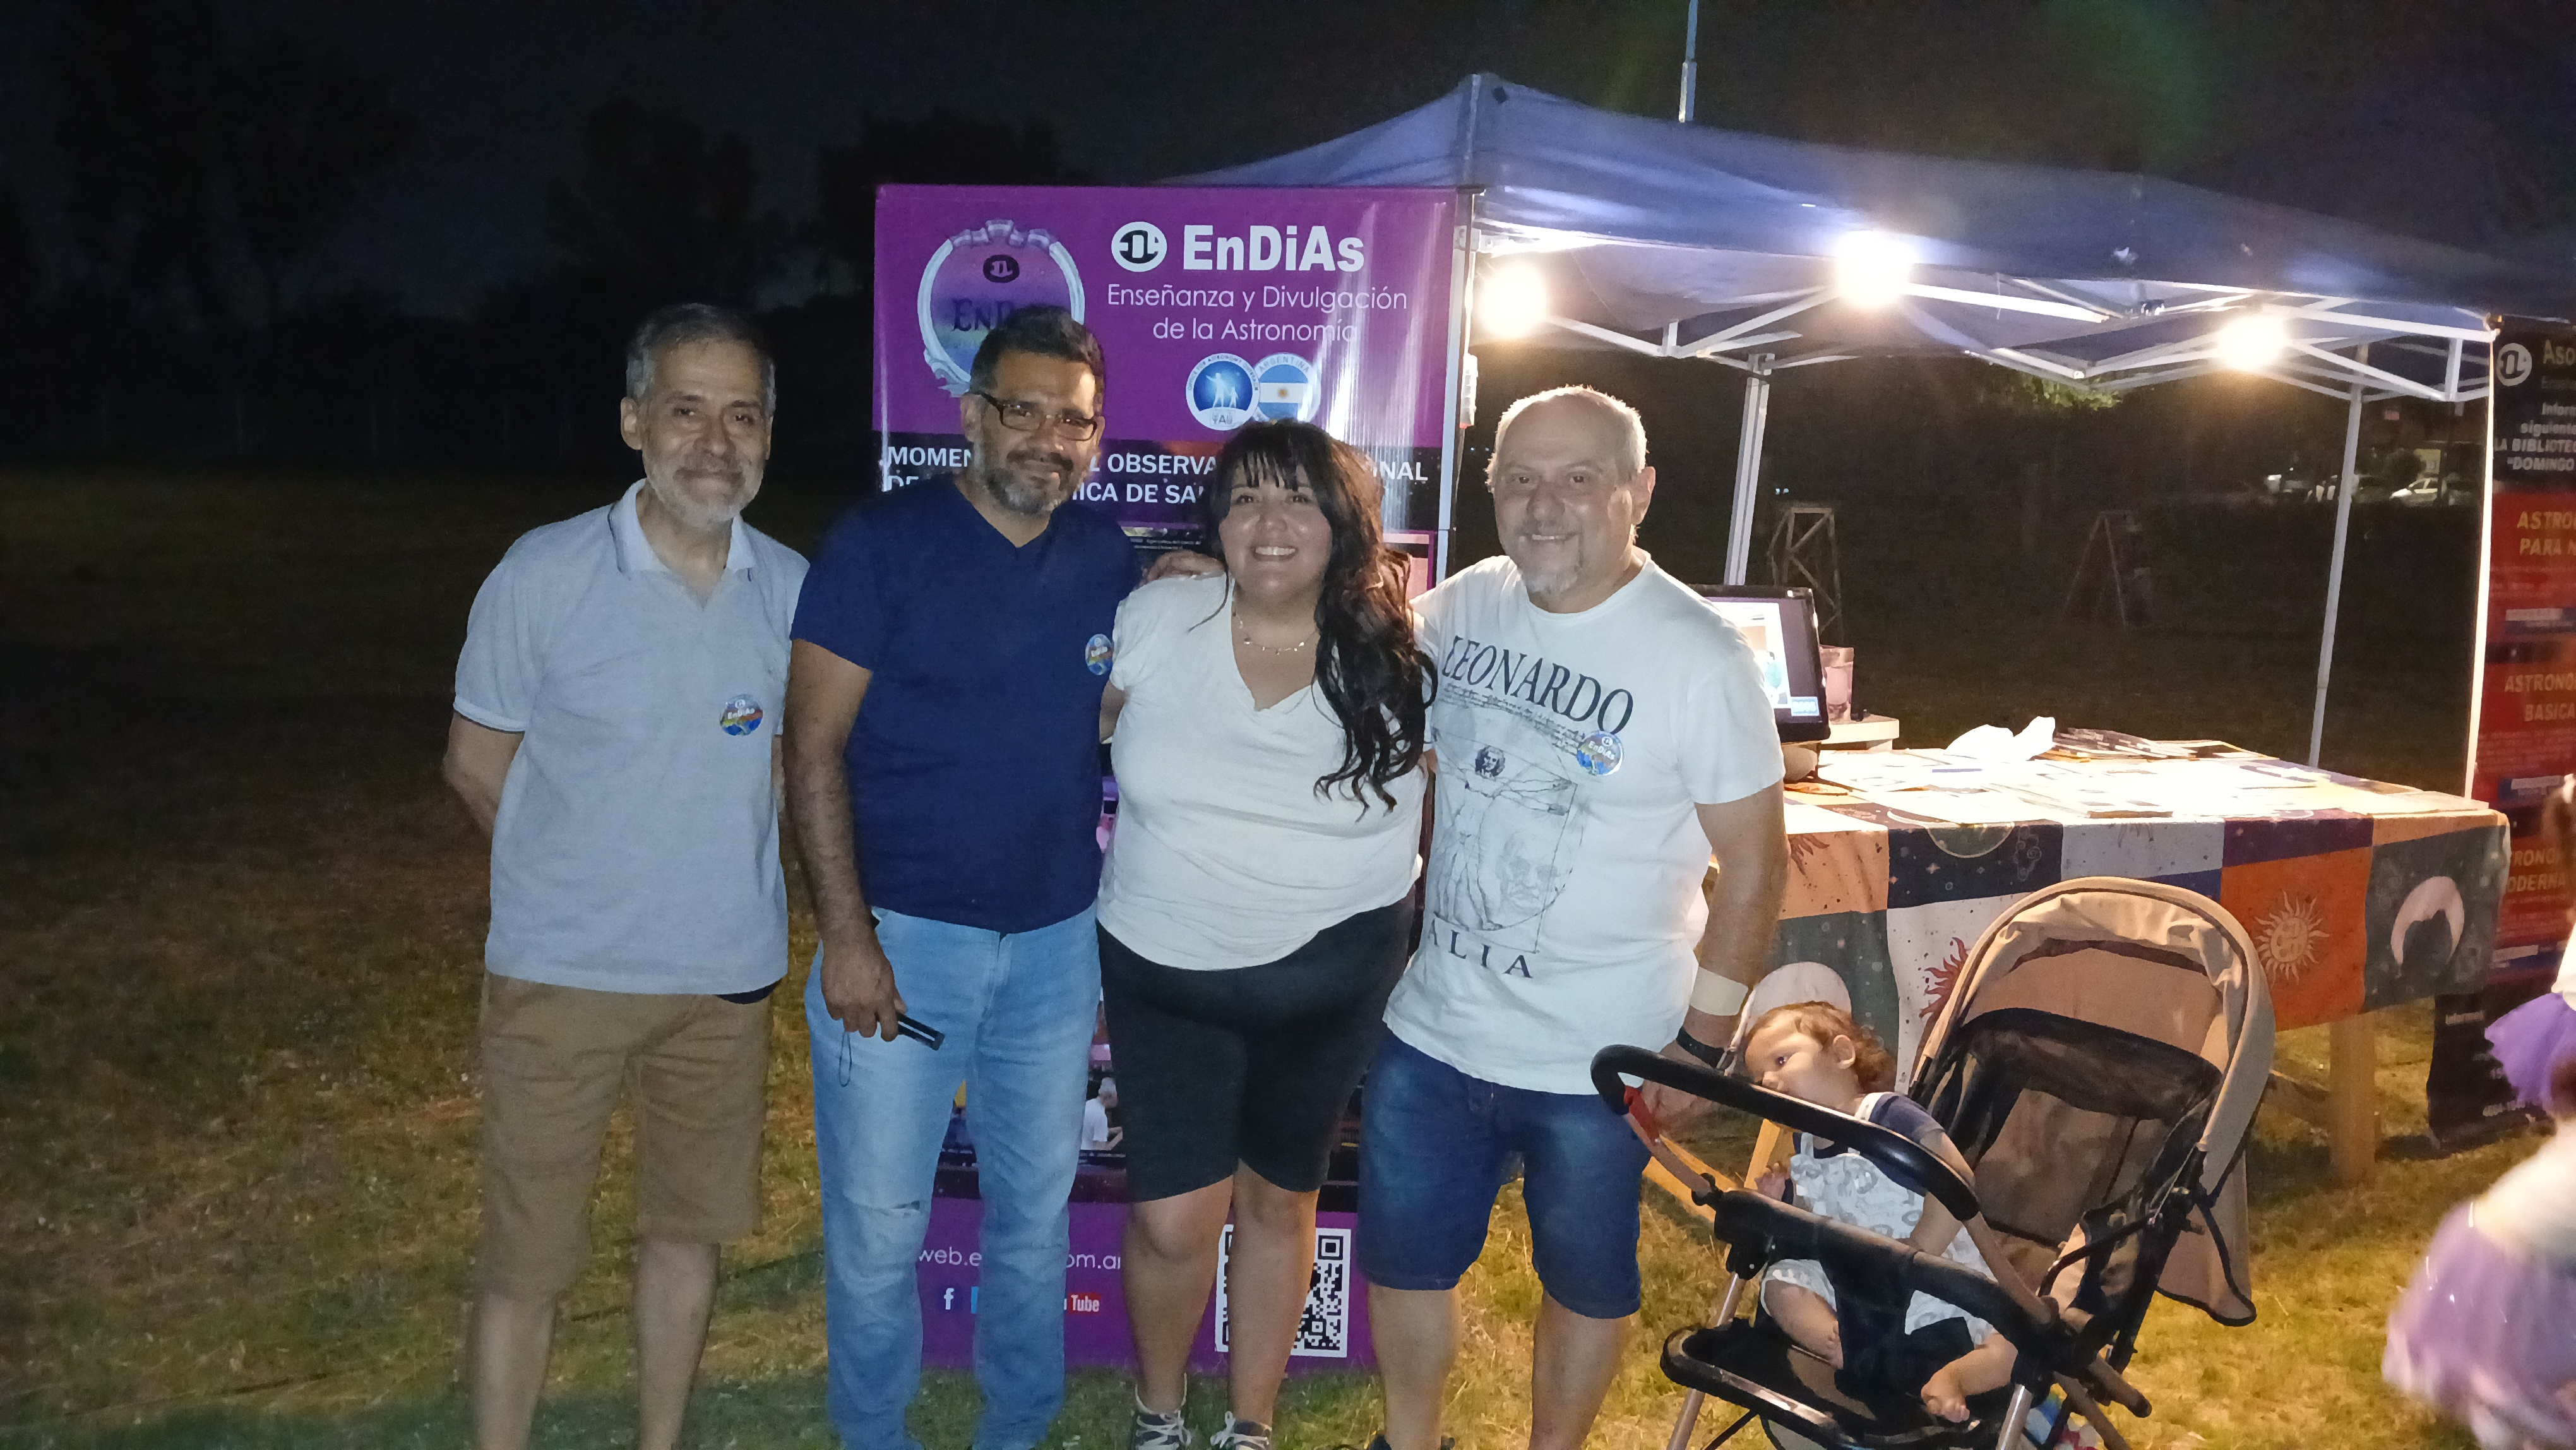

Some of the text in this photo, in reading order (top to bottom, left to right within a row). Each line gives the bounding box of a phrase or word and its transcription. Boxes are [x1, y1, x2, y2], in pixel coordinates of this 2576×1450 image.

[1183, 224, 1364, 272] EnDiAs
[1107, 284, 1407, 314] Enseñanza y Divulgación
[1153, 317, 1357, 342] de la Astronomía
[1258, 355, 1310, 374] ARGENTINA
[1107, 453, 1217, 475] OBSERVA
[1126, 483, 1158, 503] DE
[1165, 484, 1204, 504] SA
[2517, 510, 2576, 530] ASTRO
[1442, 635, 1633, 736] LEONARDO
[2505, 672, 2576, 693] ASTRONO
[2507, 872, 2567, 893] ODERNA
[1428, 918, 1533, 979] ALIA
